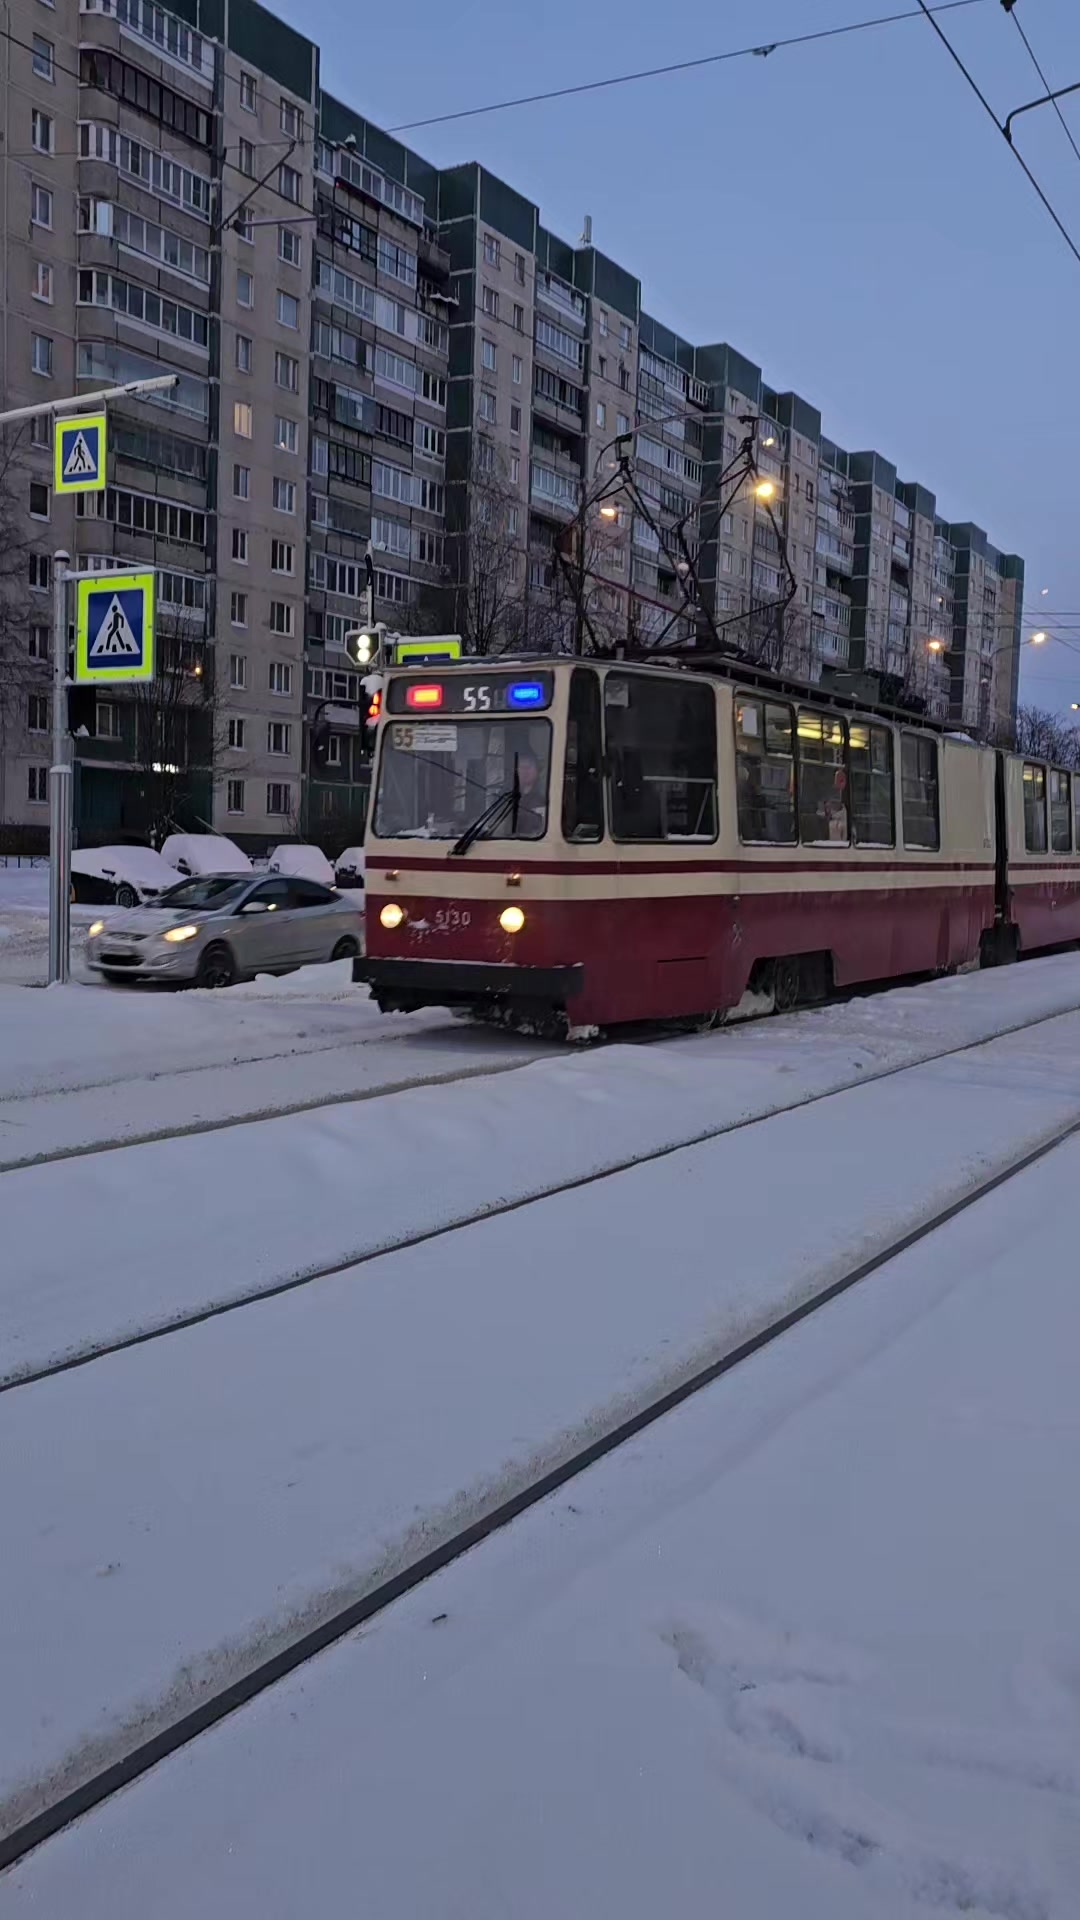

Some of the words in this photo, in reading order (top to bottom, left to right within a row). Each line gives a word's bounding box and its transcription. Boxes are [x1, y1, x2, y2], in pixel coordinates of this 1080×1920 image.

[464, 686, 490, 711] 55
[394, 727, 414, 748] 55
[435, 909, 471, 926] 5130
